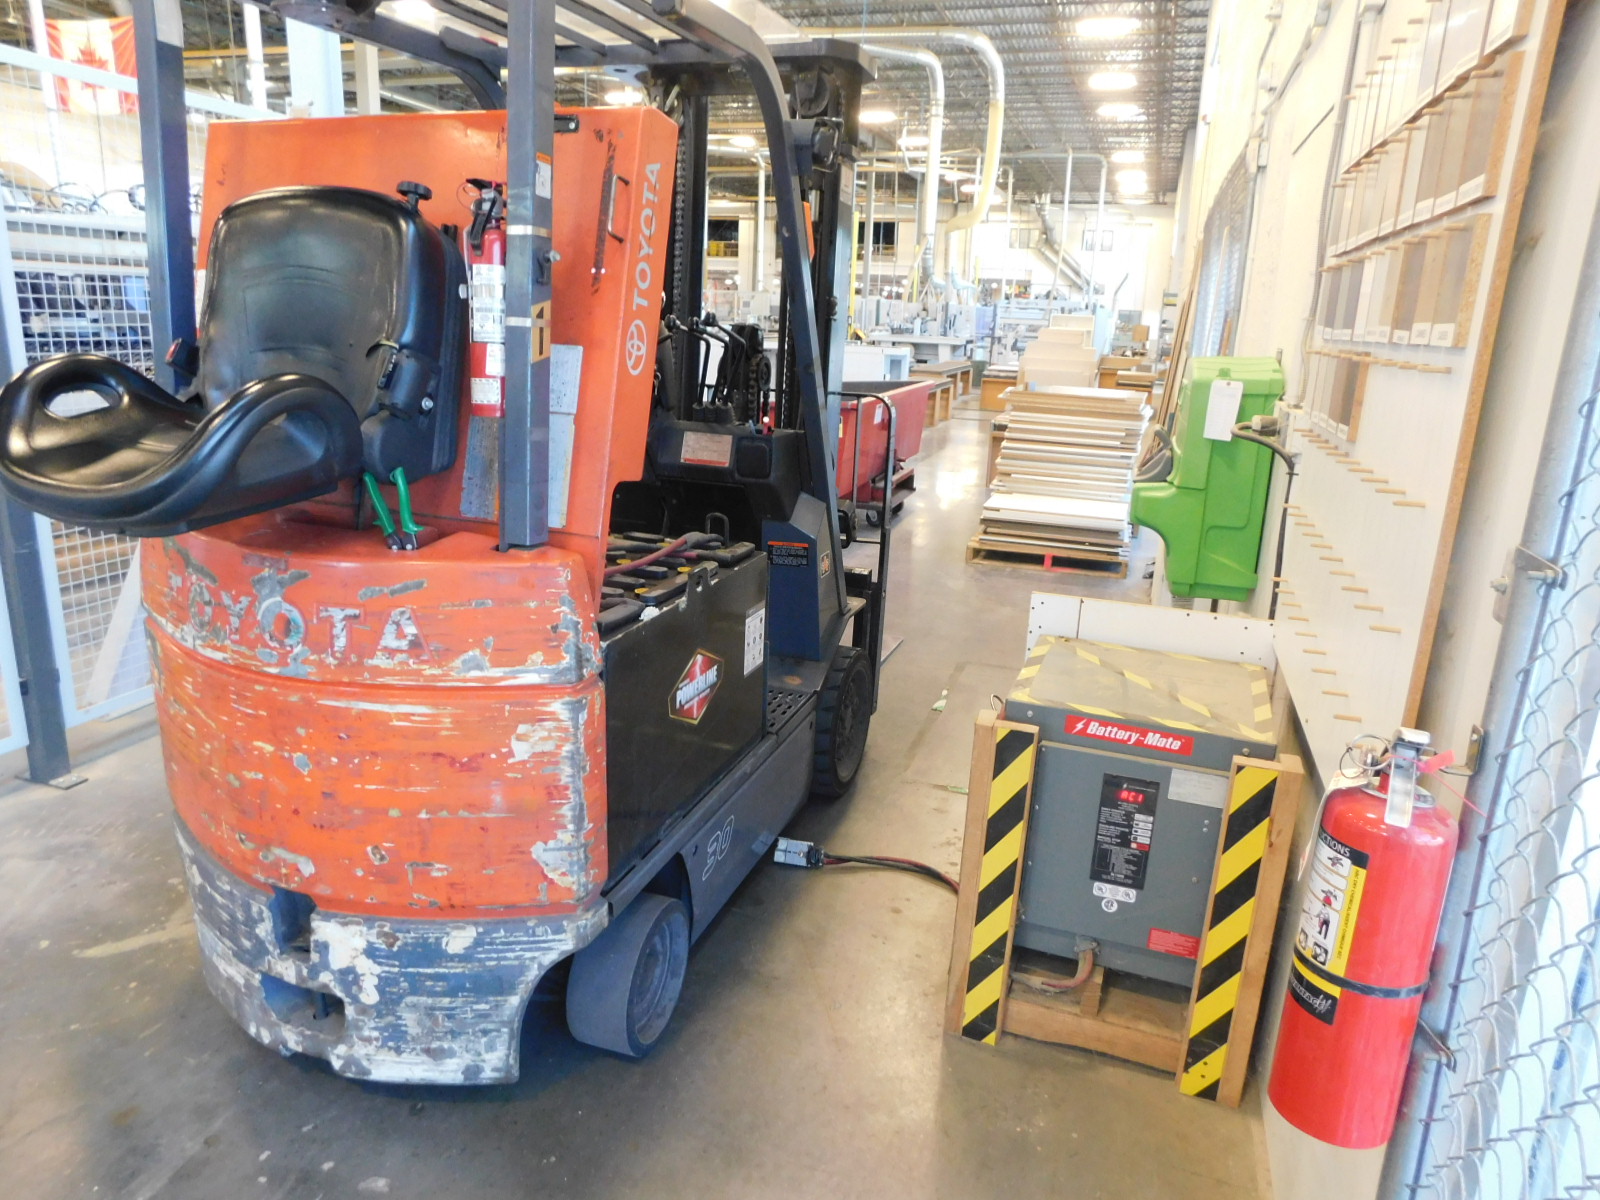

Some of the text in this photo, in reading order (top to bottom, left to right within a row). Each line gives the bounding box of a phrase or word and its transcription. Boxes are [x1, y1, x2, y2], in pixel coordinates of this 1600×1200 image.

[633, 162, 661, 311] TOYOTA
[168, 570, 433, 657] TOYOTA
[1087, 721, 1182, 750] Battery-Mate
[702, 815, 735, 882] 30
